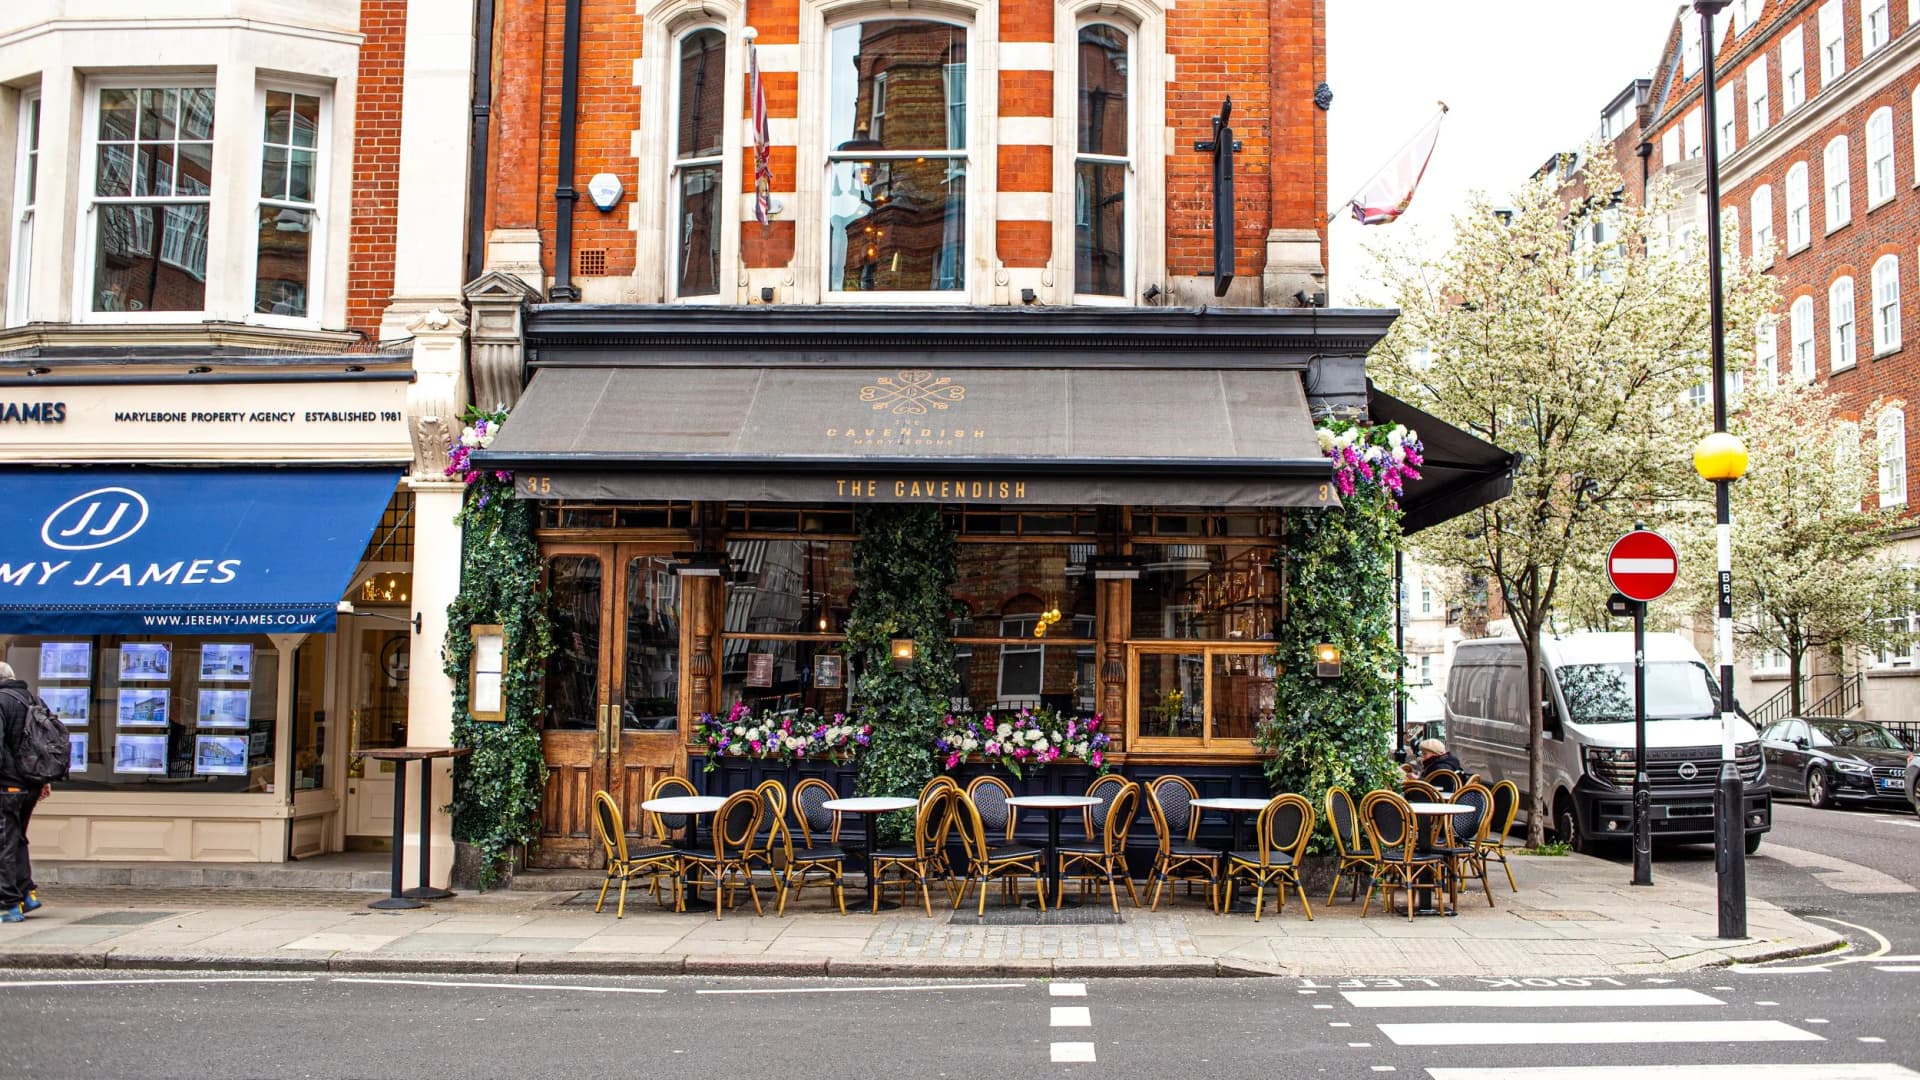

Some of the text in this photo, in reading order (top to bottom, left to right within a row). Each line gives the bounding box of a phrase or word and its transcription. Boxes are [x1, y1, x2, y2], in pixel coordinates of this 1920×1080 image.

[114, 411, 402, 422] MARYLEBONE PROPERTY AGENCY ESTABLISHED 1981
[826, 428, 986, 438] CAVENDISH
[527, 476, 551, 494] 35
[836, 480, 1026, 499] THE CAVENDISH
[60, 502, 130, 536] JJ
[73, 559, 242, 587] JAMES
[143, 614, 318, 626] WWW.JEREMY-JAMES.CO.UK
[1297, 976, 1627, 989] LOOK LEFT
